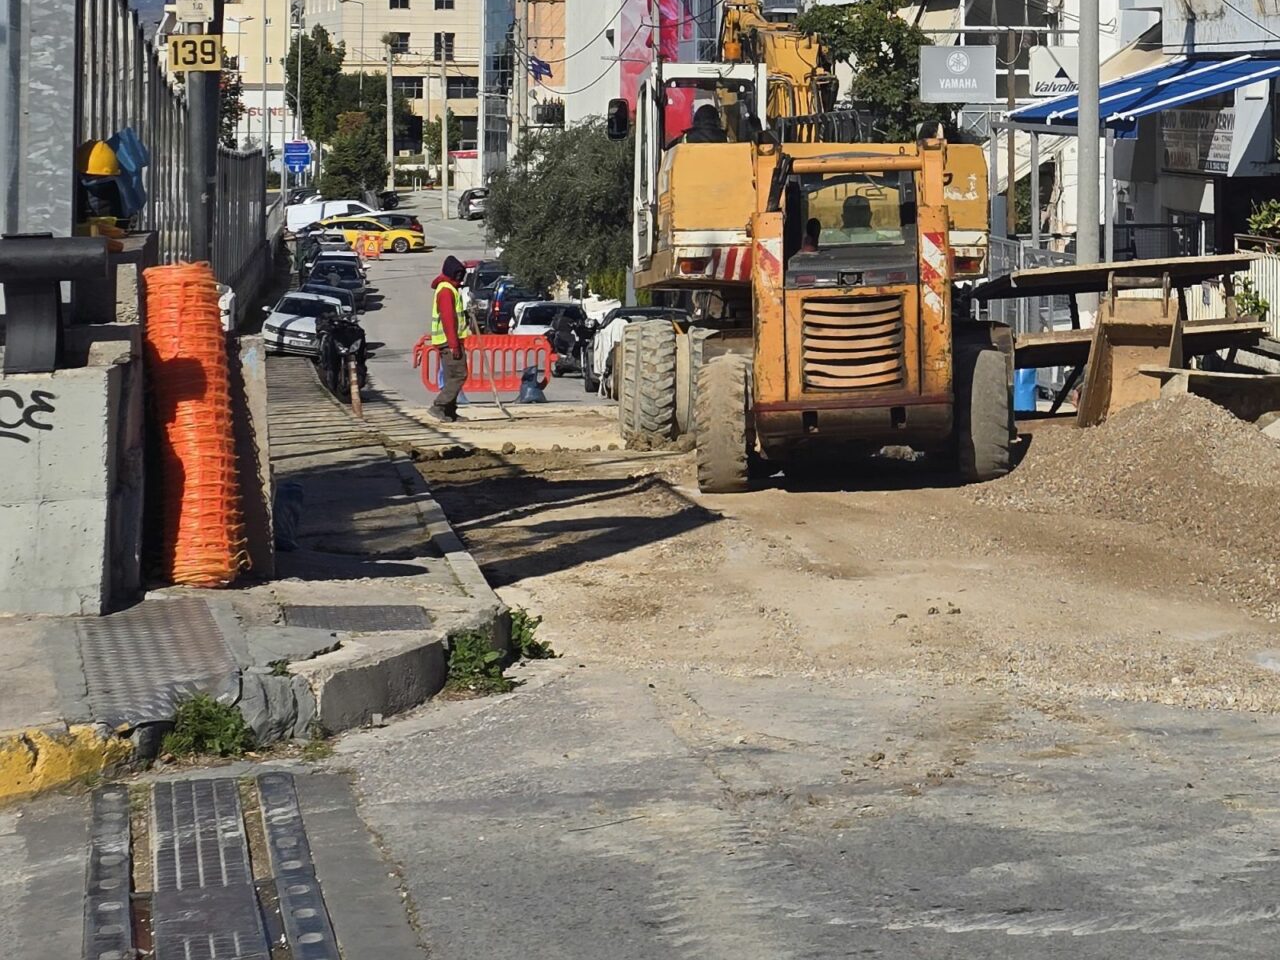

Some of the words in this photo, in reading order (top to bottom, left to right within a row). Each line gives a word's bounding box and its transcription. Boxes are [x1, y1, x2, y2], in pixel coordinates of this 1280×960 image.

[172, 40, 216, 65] 139
[938, 78, 977, 89] YAMAHA
[1035, 81, 1079, 92] Valvolin
